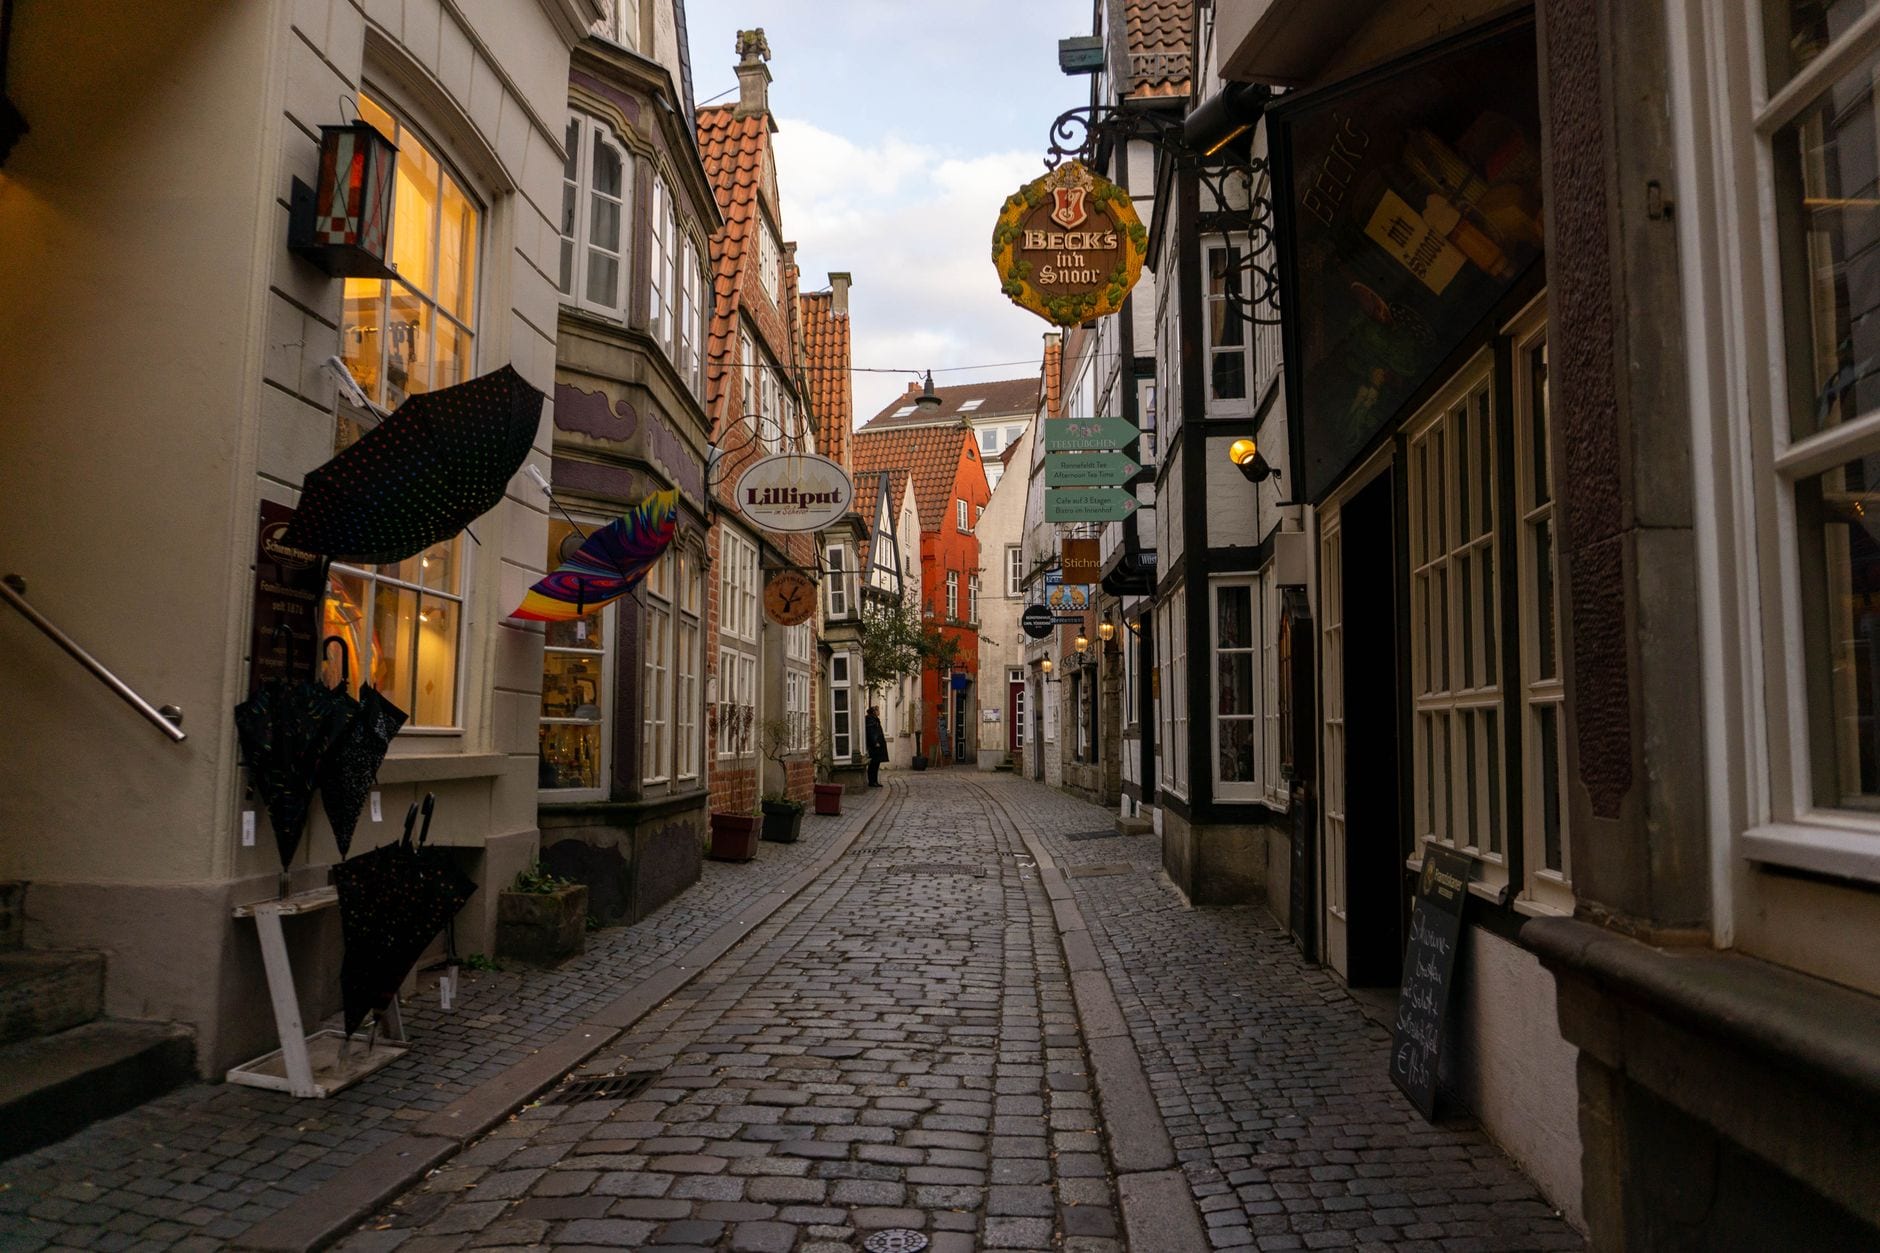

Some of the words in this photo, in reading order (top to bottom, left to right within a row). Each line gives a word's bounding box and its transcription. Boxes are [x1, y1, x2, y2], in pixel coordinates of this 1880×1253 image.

[1056, 251, 1086, 267] in'n
[1039, 265, 1100, 285] Snoor
[1051, 438, 1116, 448] TEESTÜBCHEN
[746, 487, 843, 509] Lilliput
[1090, 497, 1111, 506] Etagen
